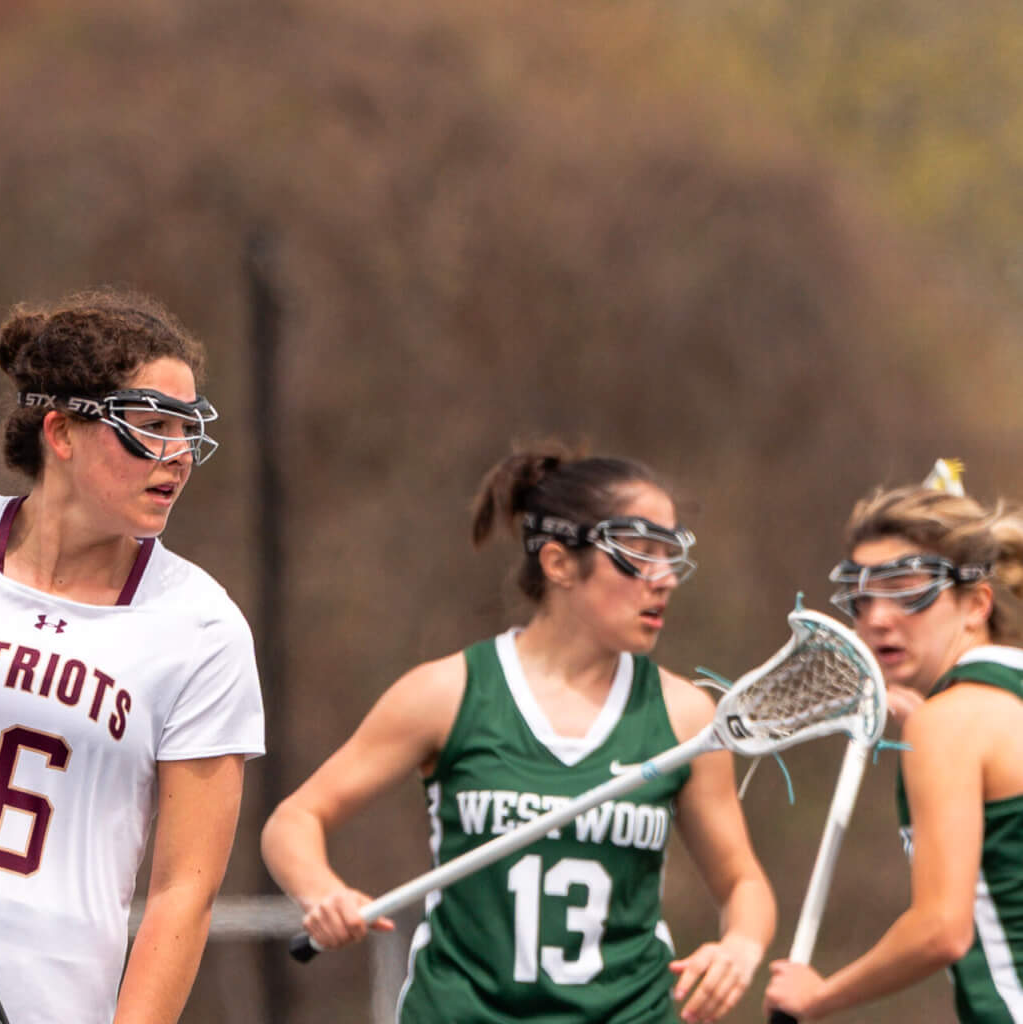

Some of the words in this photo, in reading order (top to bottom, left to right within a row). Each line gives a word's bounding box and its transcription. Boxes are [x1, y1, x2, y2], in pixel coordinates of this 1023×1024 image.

[25, 393, 57, 409] STX
[67, 397, 106, 417] STX
[507, 854, 613, 985] 13
